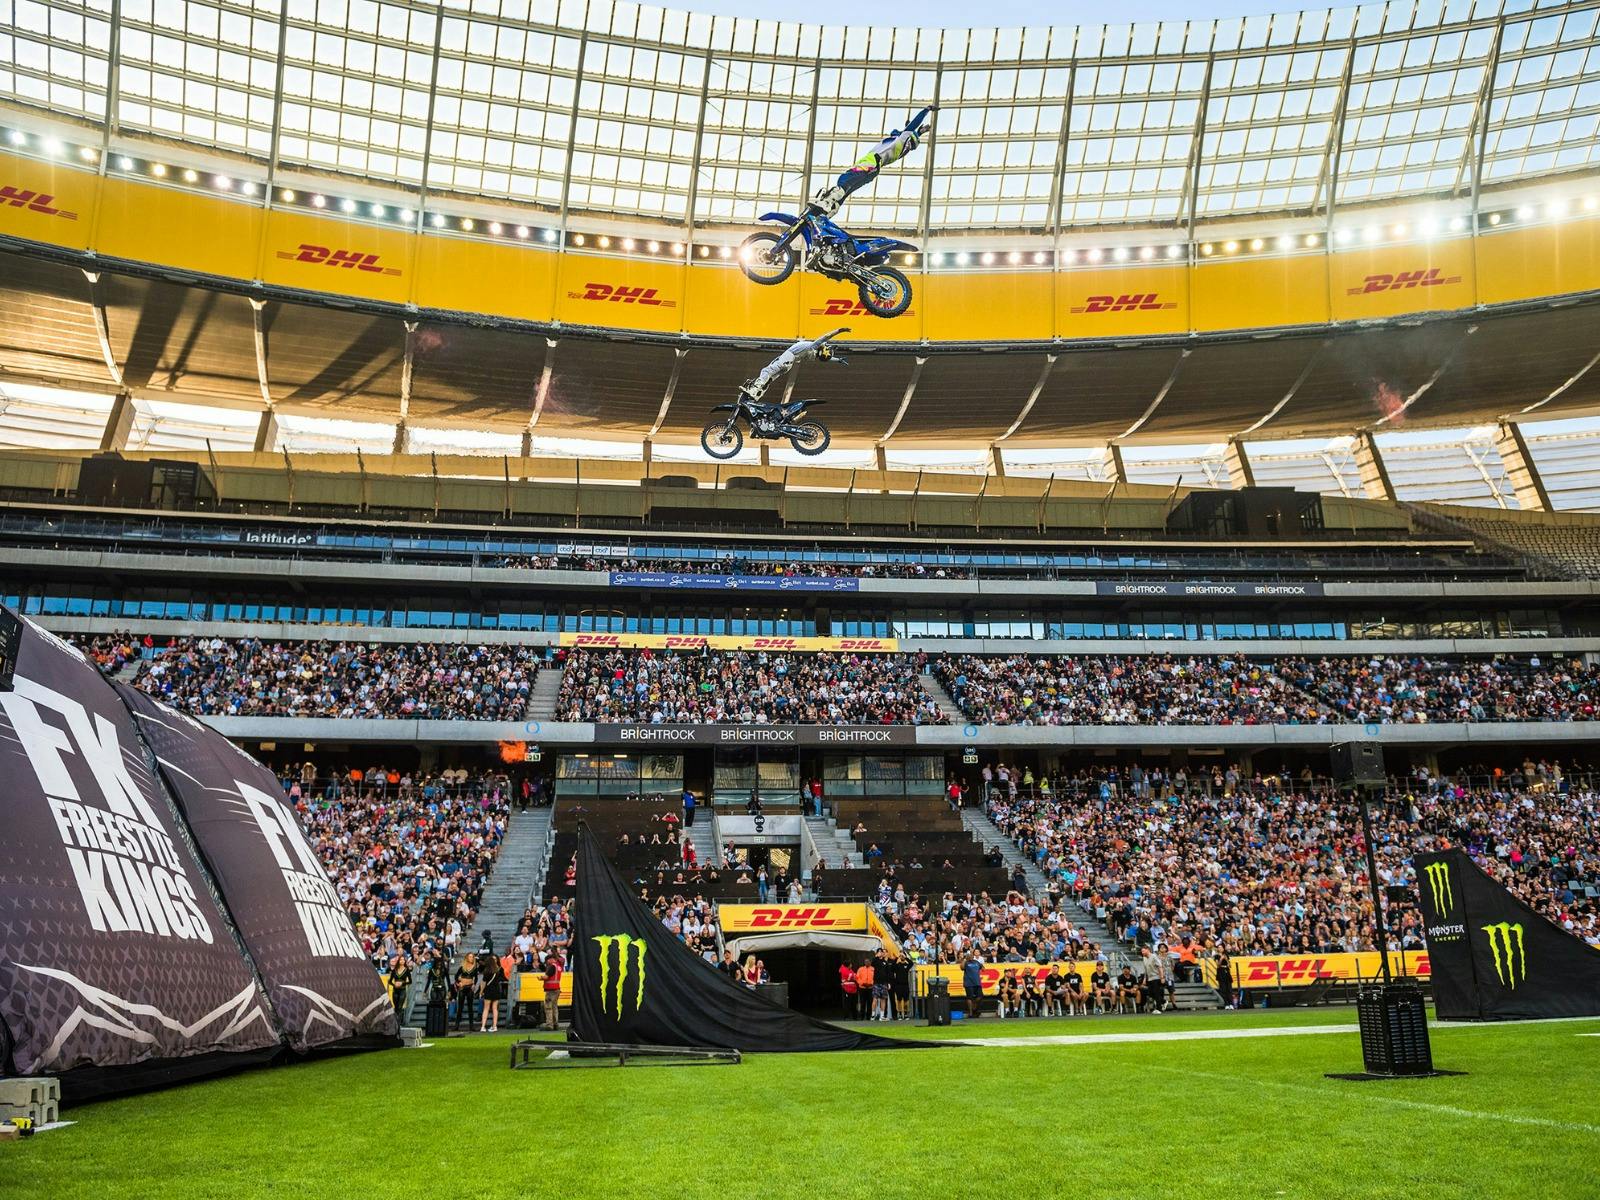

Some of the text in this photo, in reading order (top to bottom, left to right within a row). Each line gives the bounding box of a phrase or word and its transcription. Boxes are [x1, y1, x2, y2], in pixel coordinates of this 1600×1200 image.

[0, 186, 59, 215] HL
[296, 244, 385, 273] DHL
[1361, 268, 1446, 293] DHL
[582, 282, 663, 306] DHL
[1085, 293, 1165, 313] DHL
[576, 635, 621, 646] DHL
[753, 638, 798, 649] DHL
[840, 640, 884, 650] DHL
[47, 797, 188, 877] FREESTYLE
[65, 847, 214, 945] KINGS
[750, 908, 836, 928] DHL
[1428, 924, 1465, 937] MONSTER
[1247, 959, 1335, 981] DHL
